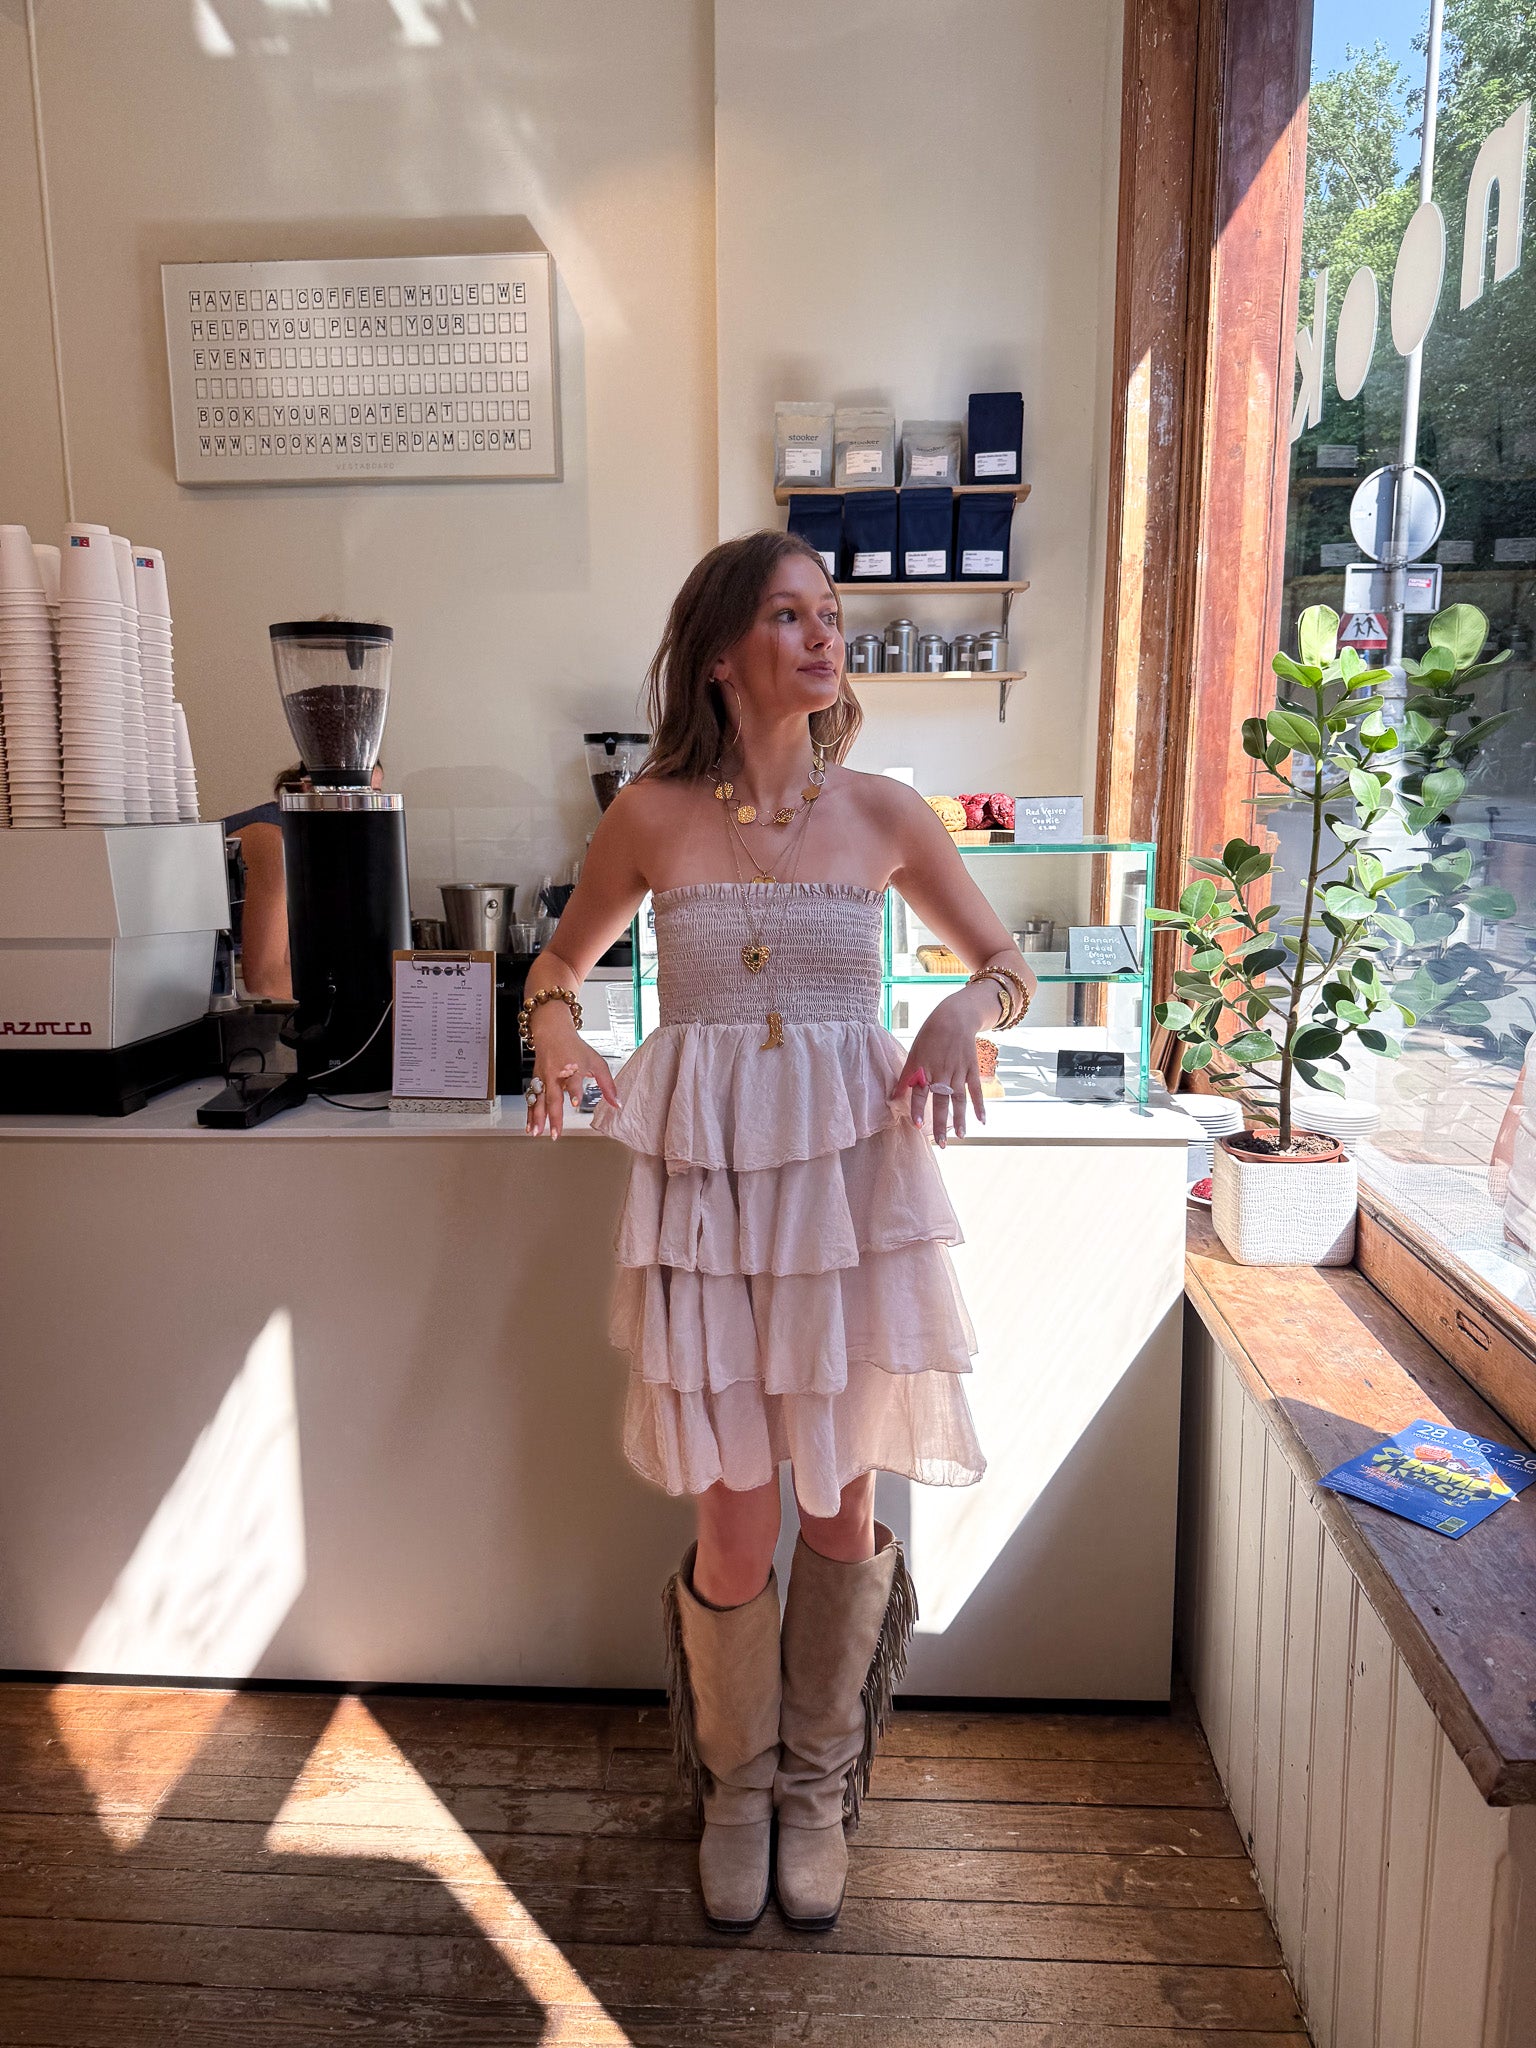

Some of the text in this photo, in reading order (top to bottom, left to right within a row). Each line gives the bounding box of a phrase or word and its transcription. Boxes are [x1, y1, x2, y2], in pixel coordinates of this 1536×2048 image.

[191, 285, 523, 306] HAVE A COFFEE WHILE WE
[193, 317, 463, 336] HELP YOU PLAN YOUR
[196, 351, 265, 365] EVENT
[200, 404, 452, 422] BOOK YOUR DATE AT
[1083, 936, 1121, 945] Banana
[421, 963, 466, 976] nook
[0, 1021, 92, 1035] RZOCCO
[1416, 1424, 1449, 1439] 28
[1462, 1437, 1496, 1454] 06
